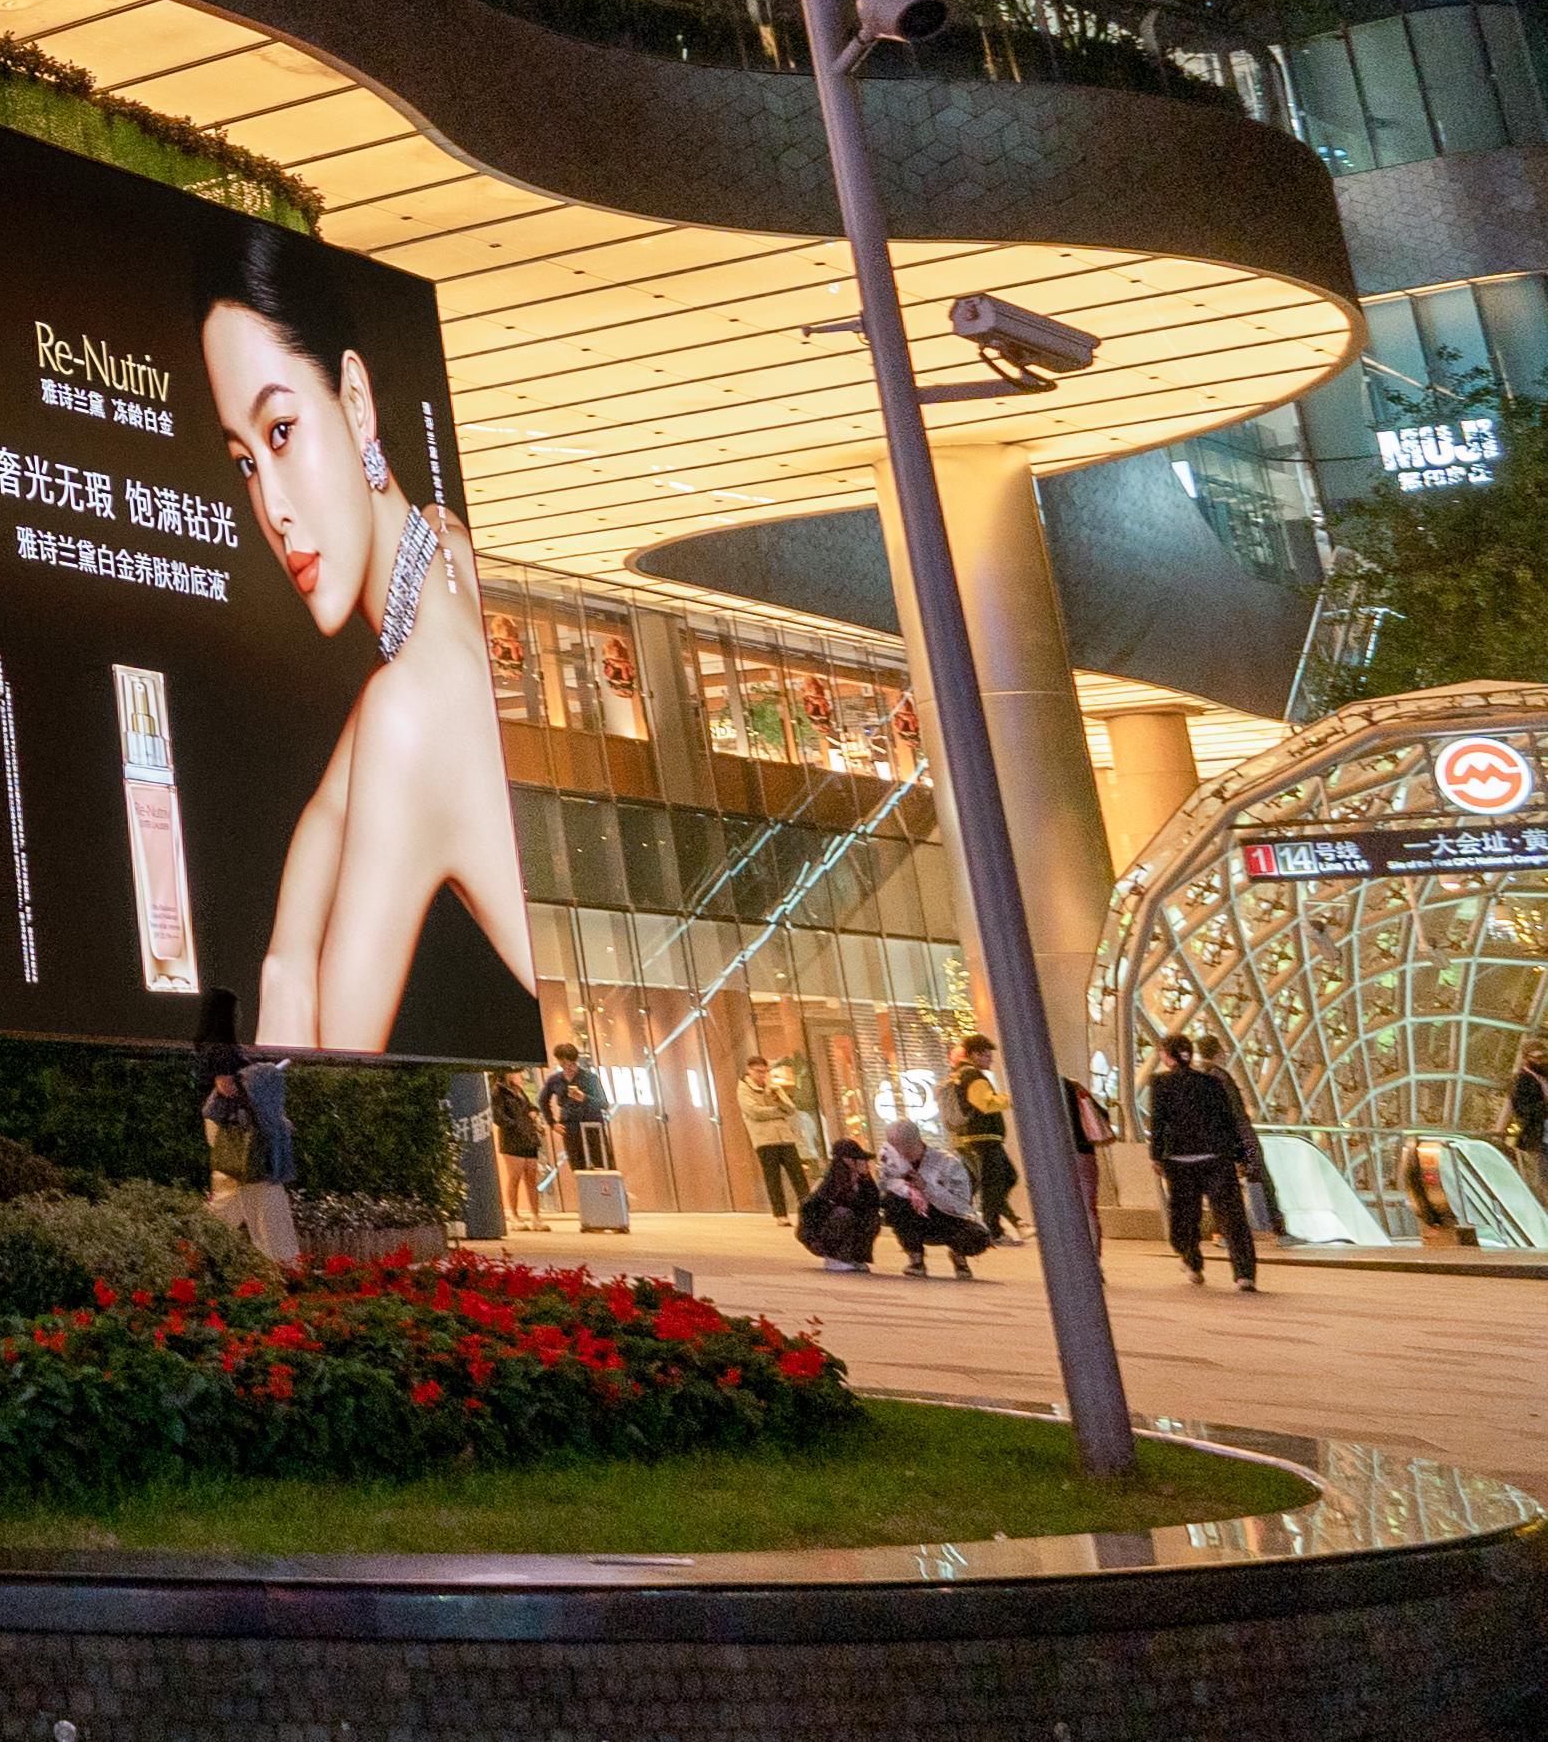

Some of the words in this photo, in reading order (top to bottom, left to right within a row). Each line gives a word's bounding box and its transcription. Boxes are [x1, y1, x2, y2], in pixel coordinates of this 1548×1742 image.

[34, 320, 170, 403] Re-Nutriv
[40, 377, 107, 420] 雅诗兰黛
[111, 398, 175, 438] 冻龄白金
[124, 478, 239, 549] 饱满钻光
[15, 525, 230, 603] 雅诗兰黛白金养肤粉底液
[1251, 848, 1268, 873] 1
[1278, 846, 1314, 871] 14
[1315, 841, 1362, 861] 号线
